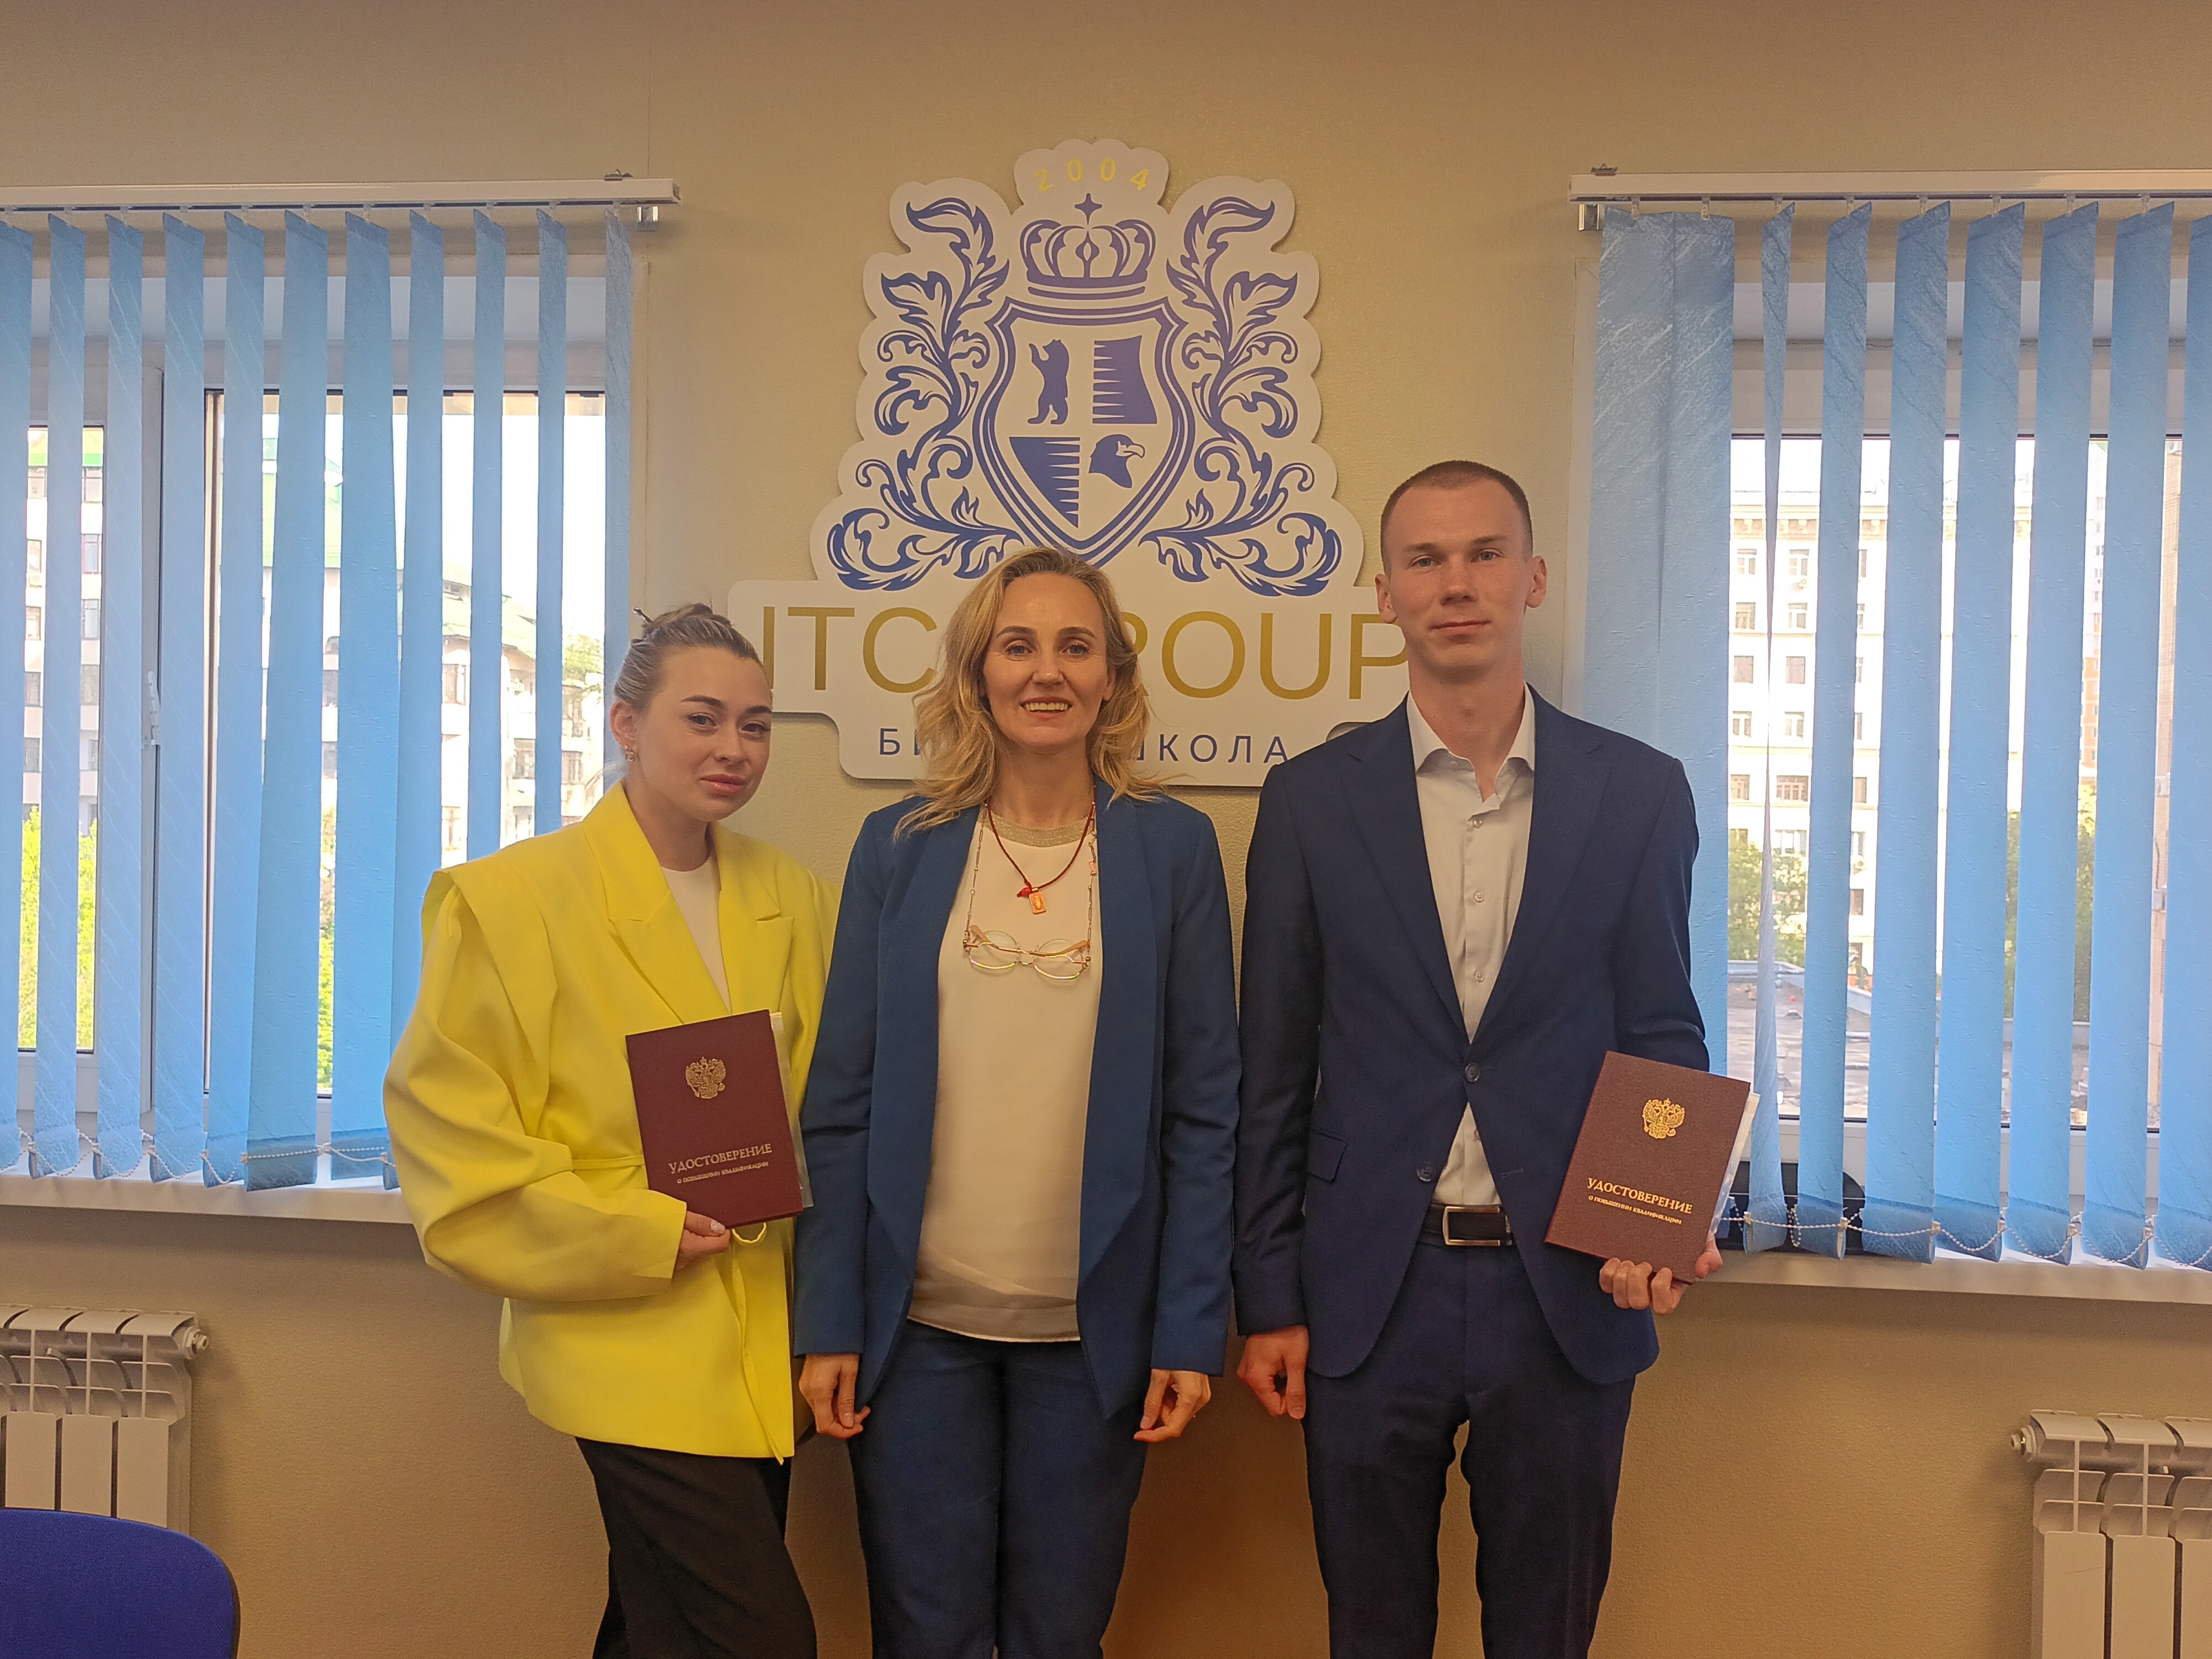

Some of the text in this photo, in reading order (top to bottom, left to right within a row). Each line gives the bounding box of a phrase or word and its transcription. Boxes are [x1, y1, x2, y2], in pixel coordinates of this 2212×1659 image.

[1034, 158, 1150, 192] 2004
[1120, 611, 1408, 700] OUP
[668, 1143, 773, 1174] УДОСТОВЕРЕНИЕ
[1587, 1177, 1693, 1214] УДОСТОВЕРЕНИЕ
